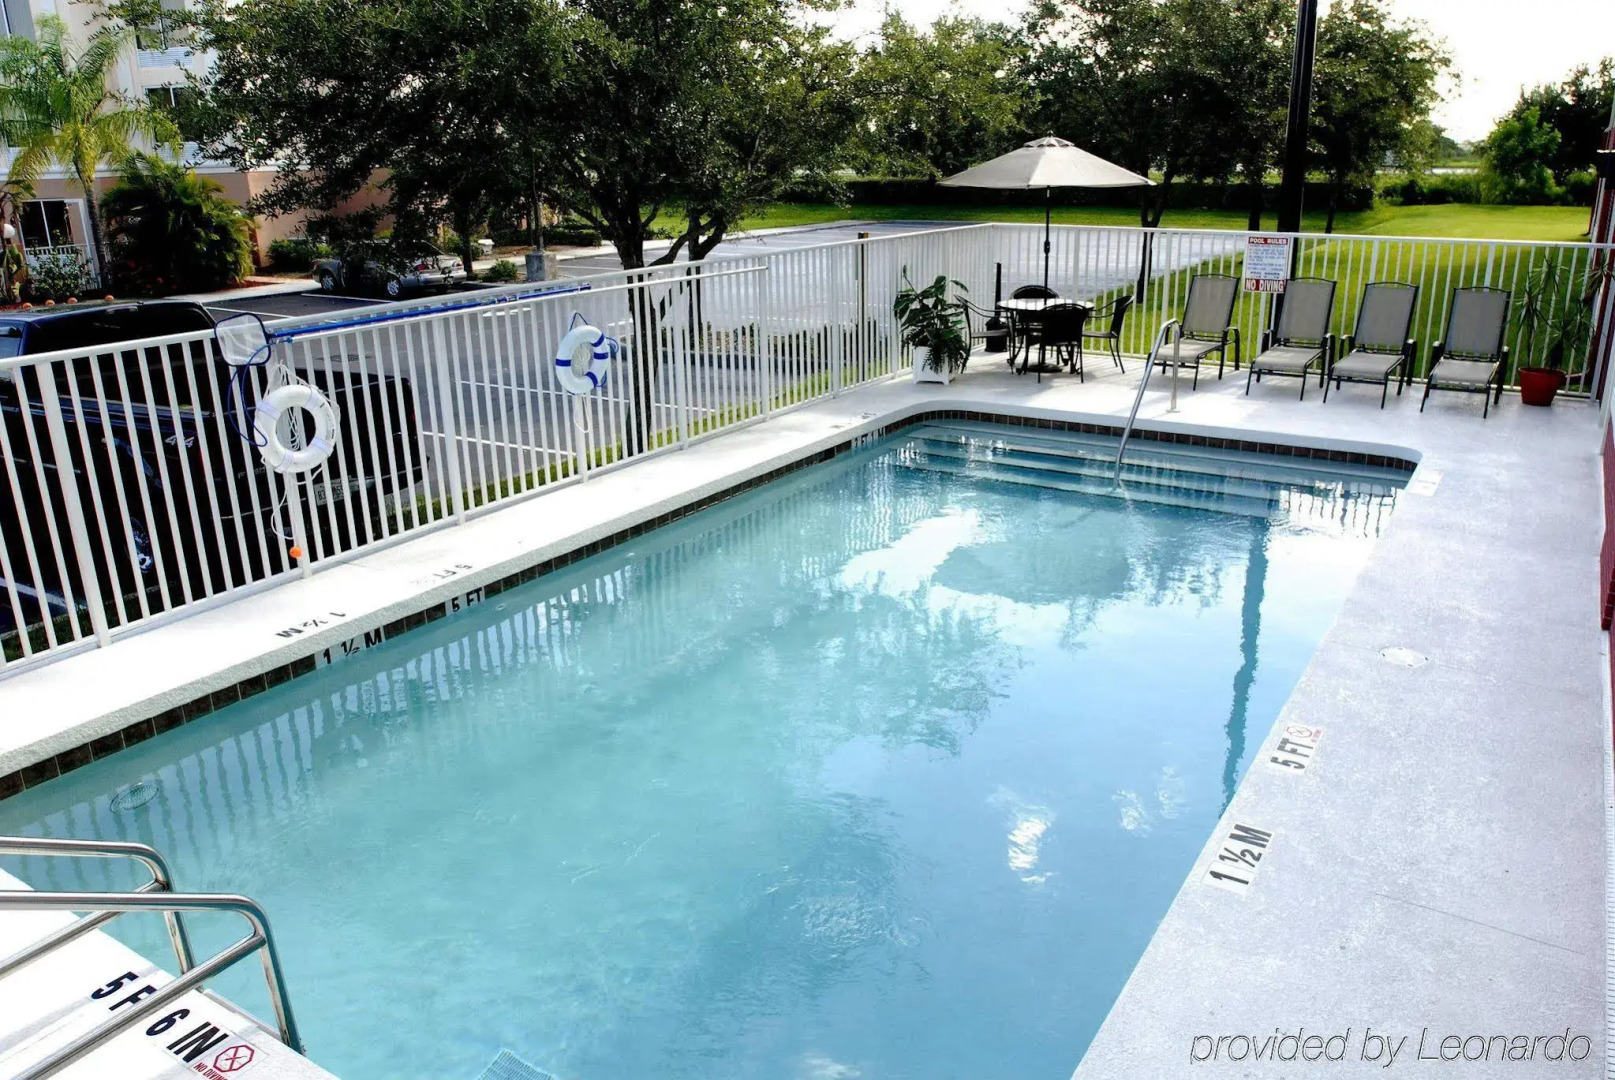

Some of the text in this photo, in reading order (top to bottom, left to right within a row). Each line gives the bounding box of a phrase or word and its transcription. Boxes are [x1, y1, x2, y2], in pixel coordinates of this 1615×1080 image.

[1245, 279, 1284, 292] NO DIVING
[165, 434, 195, 448] 44
[451, 586, 483, 613] 5 FT
[275, 627, 304, 638] M
[323, 647, 332, 665] 1
[363, 626, 383, 649] M
[1270, 737, 1314, 770] 5 FT
[1228, 823, 1272, 849] M
[1209, 870, 1249, 885] 1
[91, 971, 158, 1012] 5 F
[146, 1008, 230, 1064] 6 IN
[193, 1062, 208, 1073] NO
